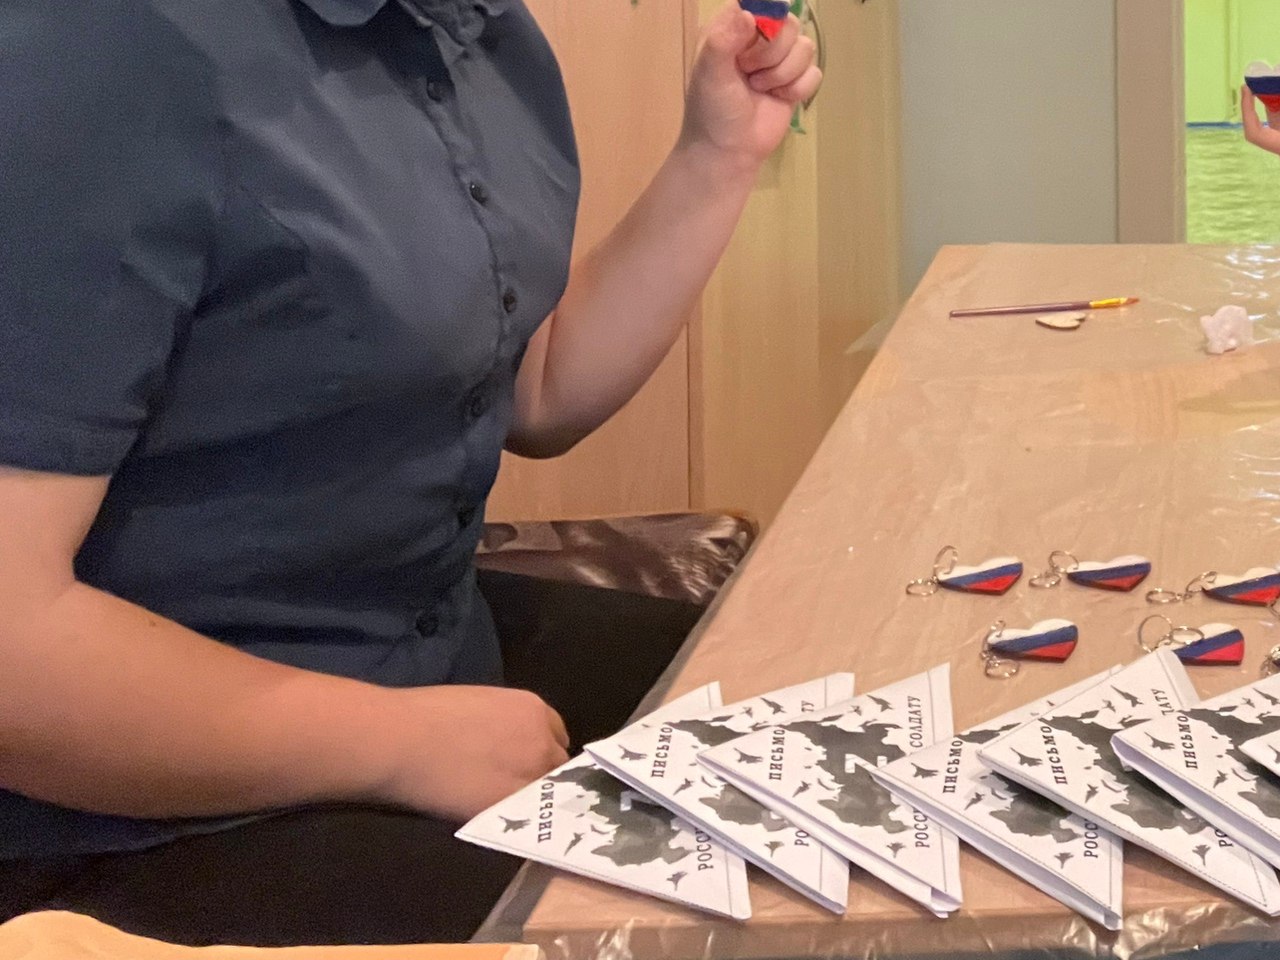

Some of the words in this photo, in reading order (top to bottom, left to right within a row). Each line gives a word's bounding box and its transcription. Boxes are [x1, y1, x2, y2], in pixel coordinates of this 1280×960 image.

[907, 695, 924, 749] СОЛДАТУ
[1176, 715, 1199, 770] ПИСЬМО
[650, 726, 674, 779] ПИСЬМО
[768, 728, 786, 781] ПИСЬМО
[942, 739, 964, 794] ПИСЬМО
[1040, 725, 1068, 786] ПИСЬМО
[537, 781, 555, 844] ПИСЬМО
